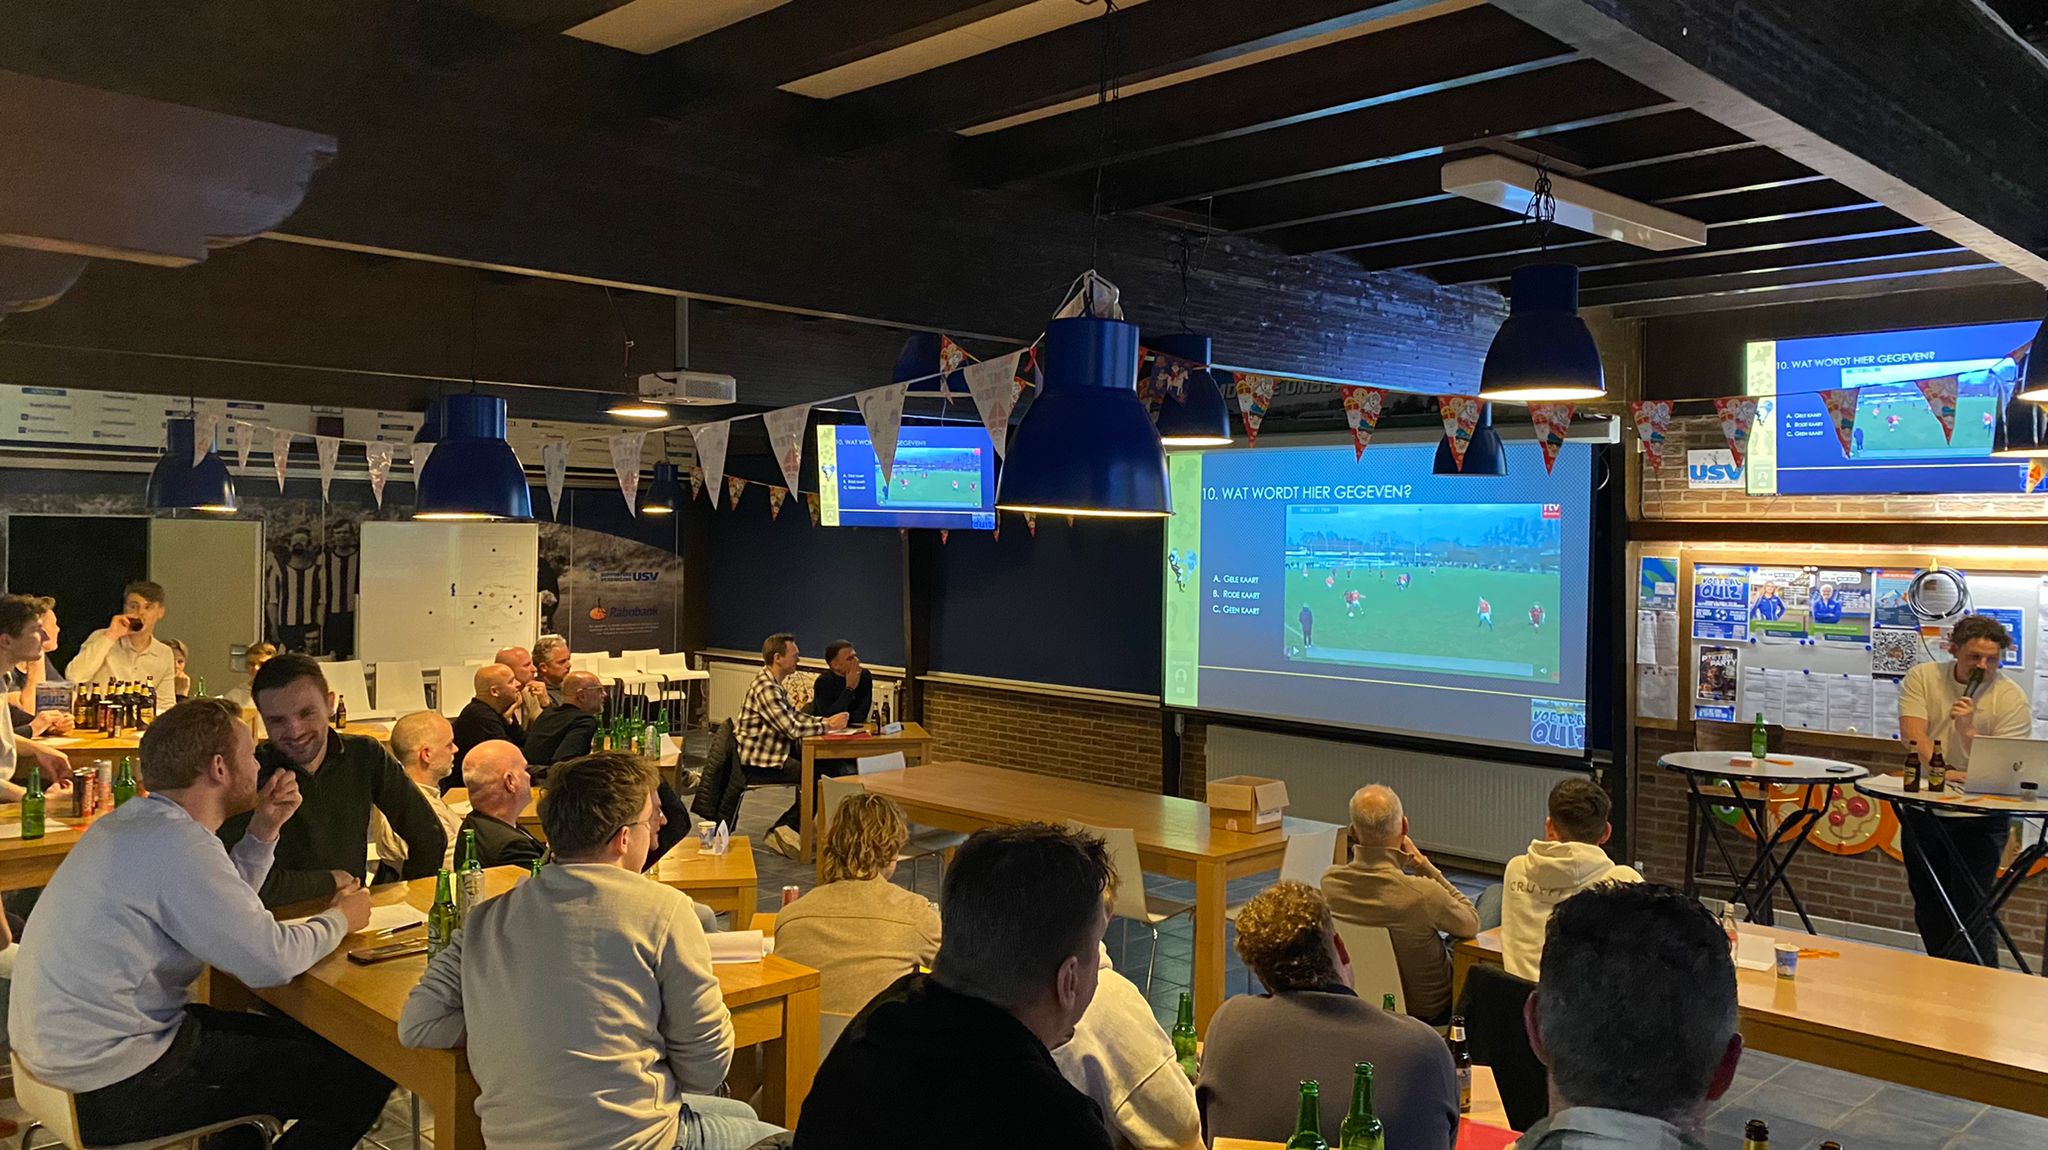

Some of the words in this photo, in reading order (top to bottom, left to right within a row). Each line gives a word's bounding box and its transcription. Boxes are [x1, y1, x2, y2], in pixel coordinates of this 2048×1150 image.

[1776, 361, 1790, 370] 10.
[1791, 360, 1813, 369] WAT
[1814, 357, 1851, 368] WORDT
[1853, 355, 1876, 365] HIER
[1877, 351, 1936, 364] GEGEVEN?
[1689, 464, 1745, 481] USV
[1202, 487, 1219, 501] 10.
[1222, 486, 1251, 500] WAT
[1252, 486, 1299, 500] WORDT
[1302, 485, 1331, 499] HIER
[1334, 484, 1413, 499] GEGEVEN?
[632, 571, 659, 582] USV
[1212, 574, 1221, 583] A.
[1701, 584, 1741, 600] QUIZ
[610, 607, 658, 618] Rabobank
[1212, 604, 1221, 614] C.
[1711, 658, 1737, 667] PARTY
